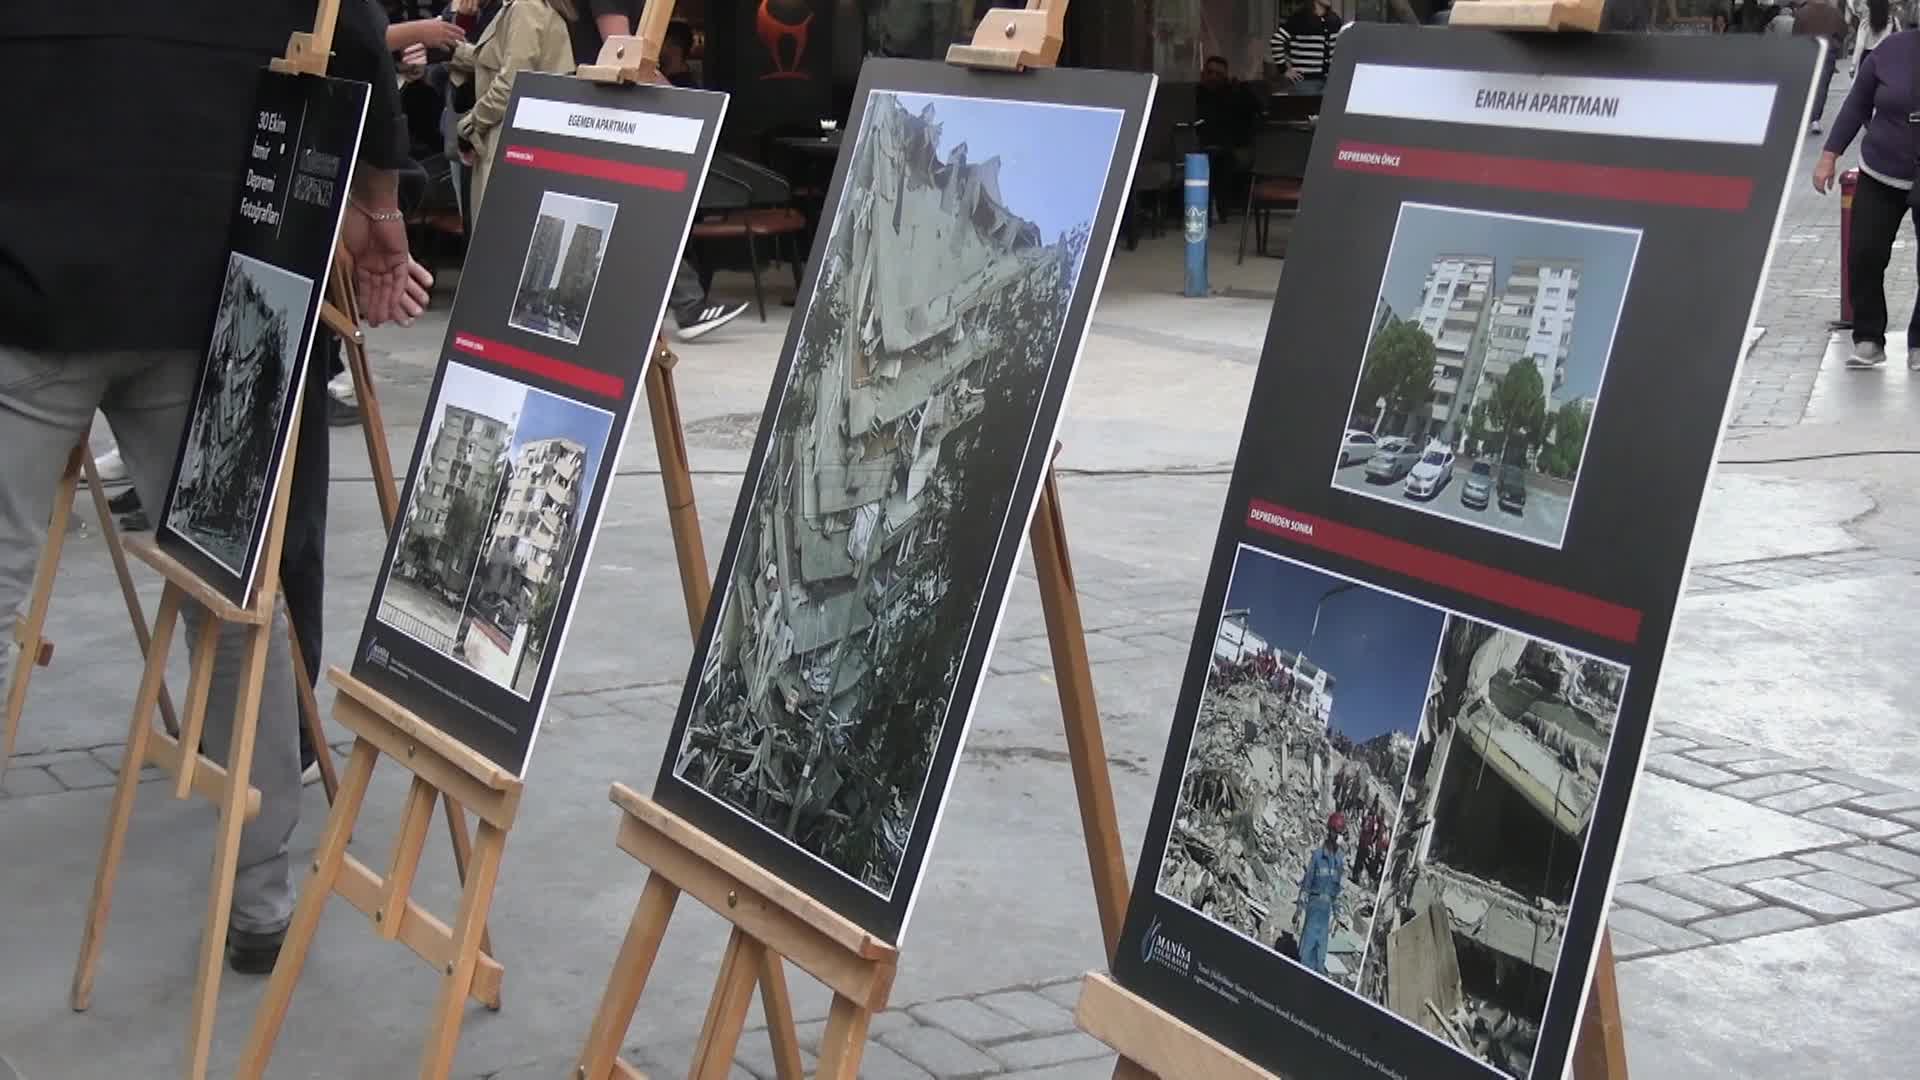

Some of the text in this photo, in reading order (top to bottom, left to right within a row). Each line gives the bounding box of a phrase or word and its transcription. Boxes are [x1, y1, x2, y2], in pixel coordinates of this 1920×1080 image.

[1475, 88, 1620, 118] EMRAH APARTMANI
[258, 111, 287, 134] 30 Ekim
[568, 114, 637, 135] EGEMEN APARTMANI
[1338, 149, 1381, 165] DEPREMDEN
[246, 168, 277, 192] Depremi
[1250, 508, 1291, 529] DEPREMDEN
